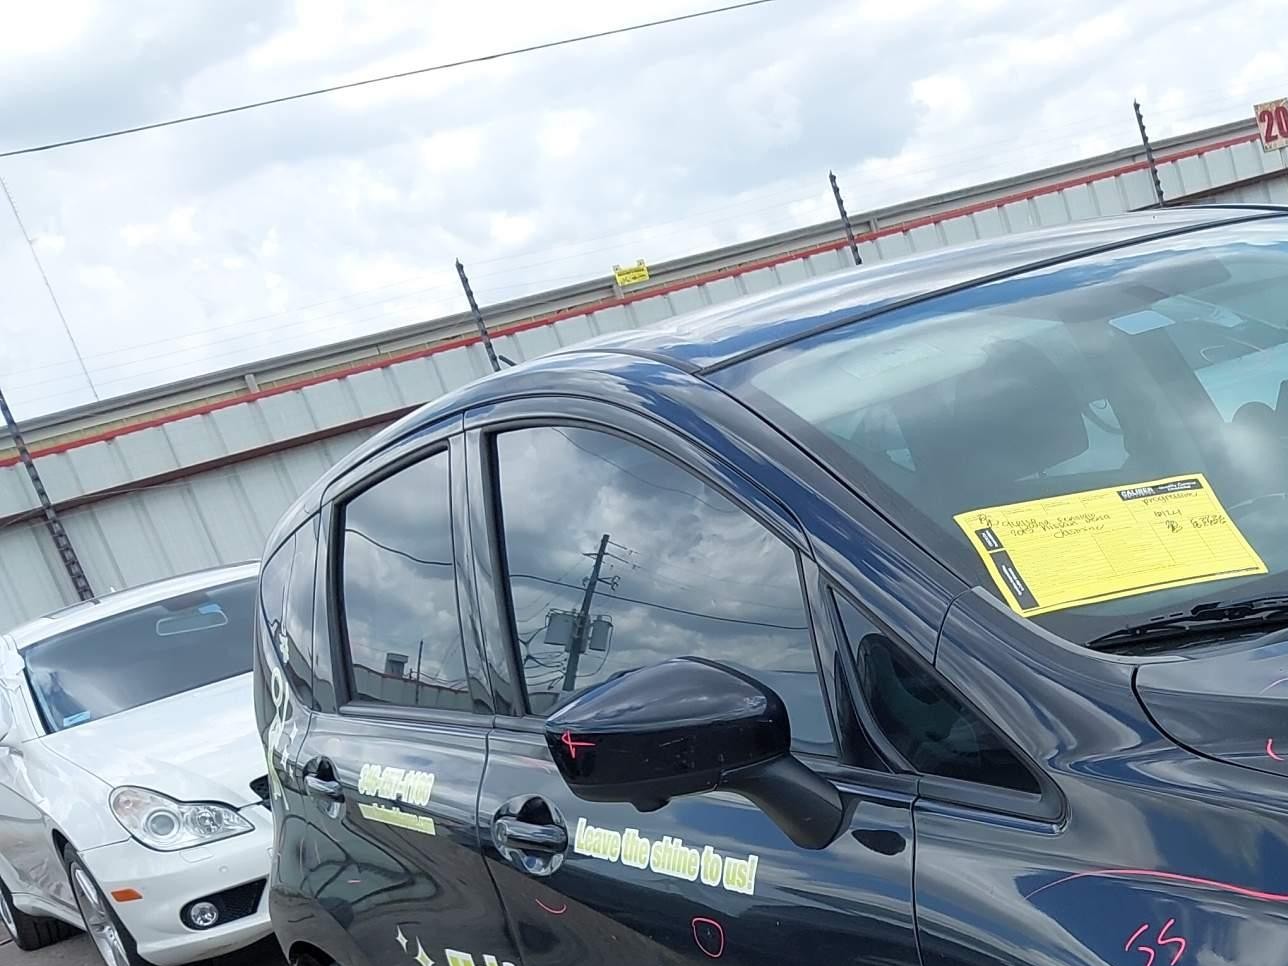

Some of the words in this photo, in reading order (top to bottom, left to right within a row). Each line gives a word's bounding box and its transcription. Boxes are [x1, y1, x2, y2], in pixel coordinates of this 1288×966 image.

[574, 816, 621, 863] Leave
[621, 827, 650, 870] the
[650, 836, 700, 882] shine
[701, 845, 723, 887] to
[723, 854, 759, 896] us!
